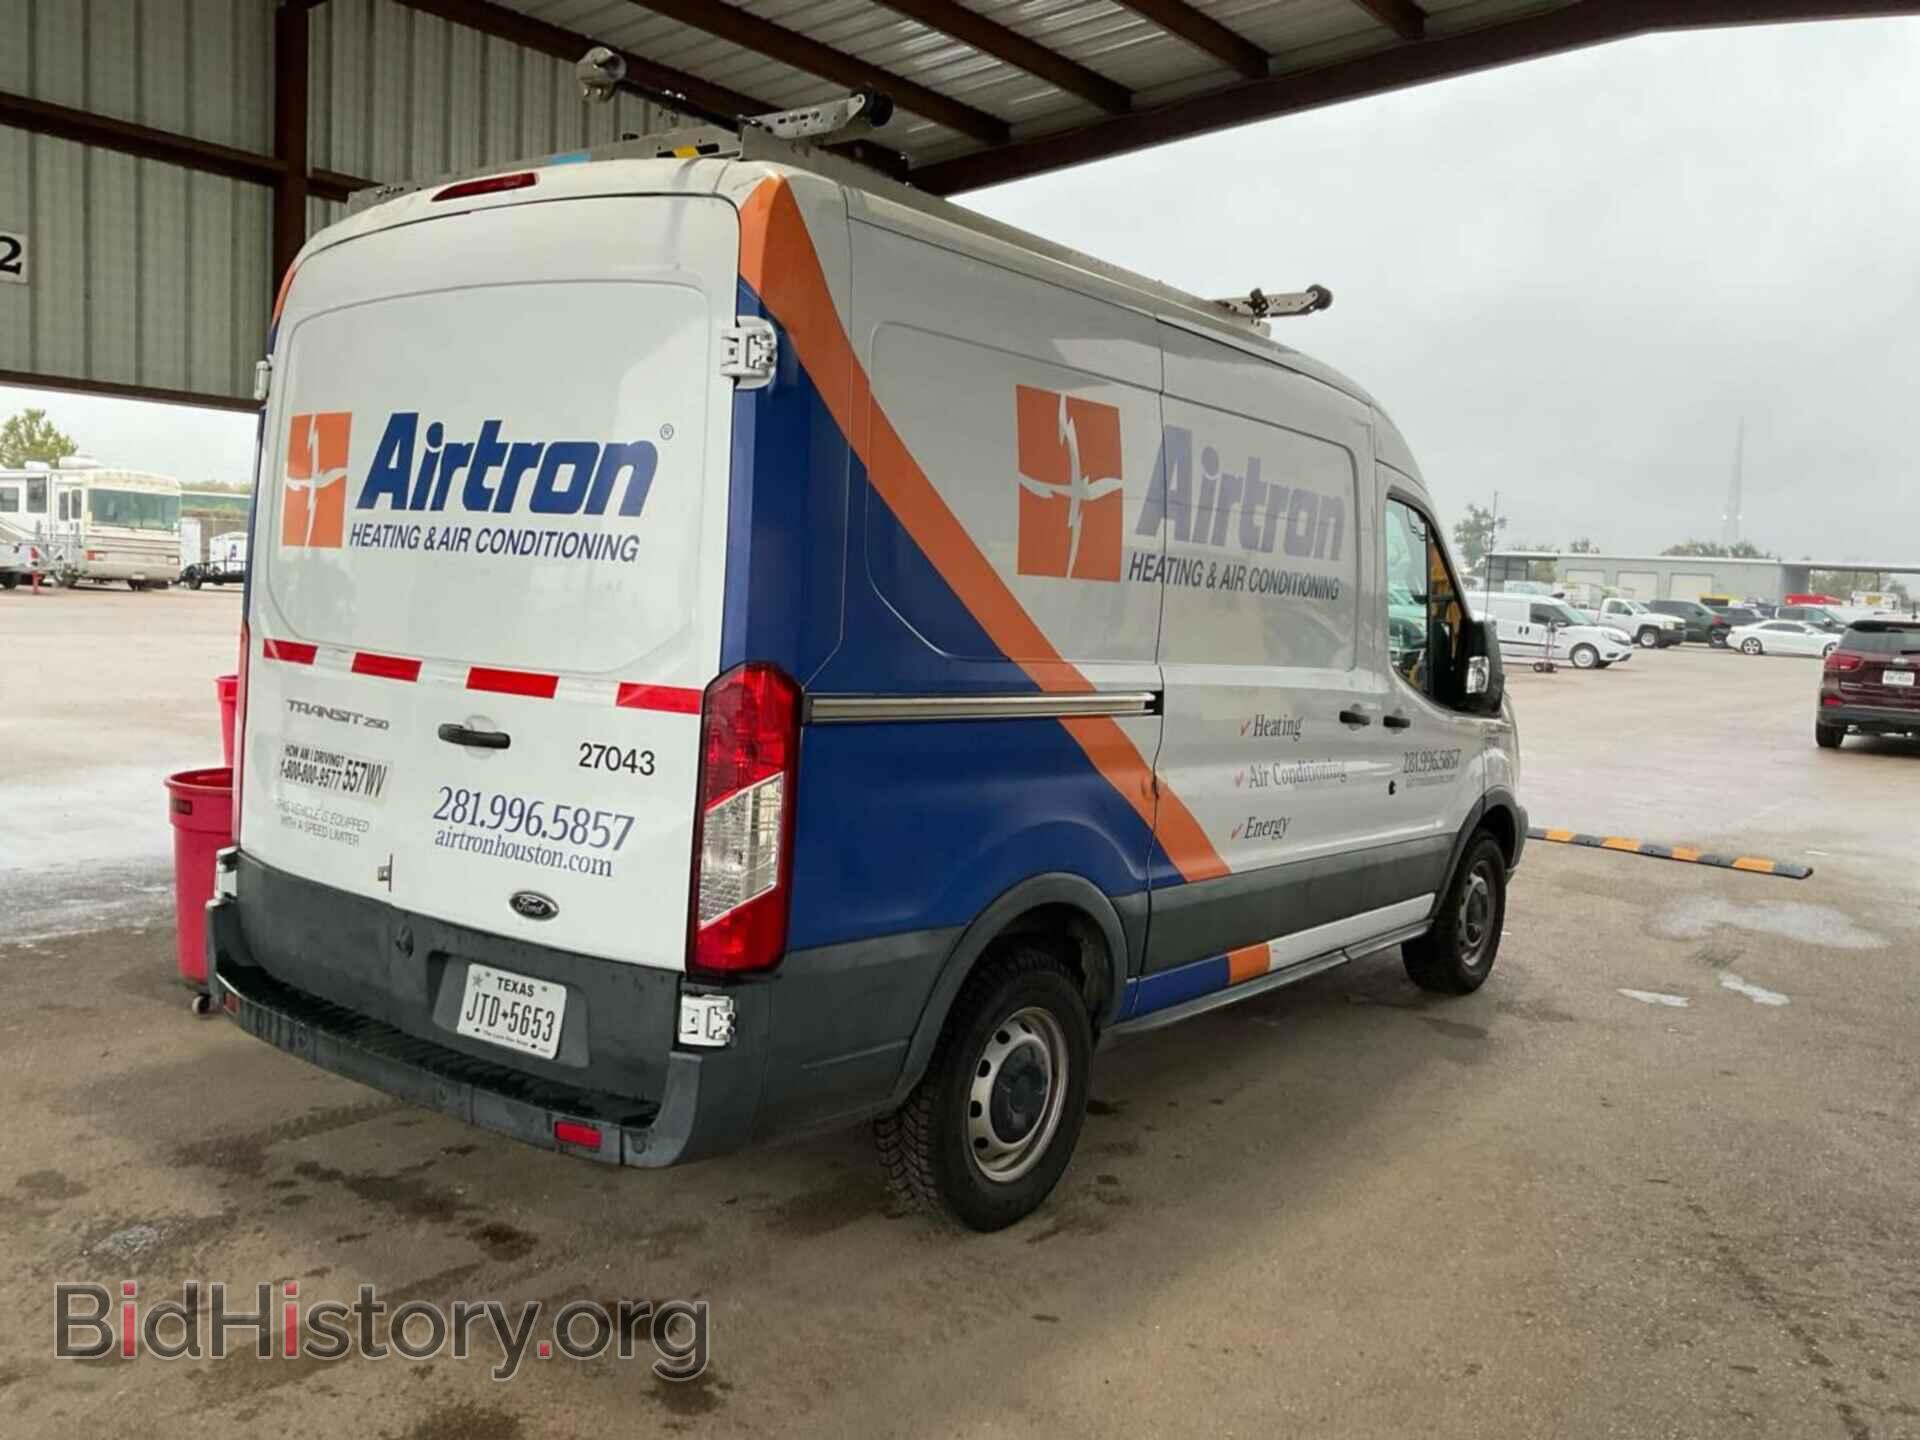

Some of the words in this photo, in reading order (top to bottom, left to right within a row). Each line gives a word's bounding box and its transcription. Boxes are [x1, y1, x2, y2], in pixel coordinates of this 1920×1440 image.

[355, 411, 659, 517] Airtron
[1135, 424, 1346, 562] Airtron
[350, 523, 420, 550] HEATING
[474, 529, 641, 562] CONDITIONING
[1128, 551, 1204, 588] HEATING
[1206, 563, 1216, 588] &
[1220, 564, 1247, 591] AIR
[1249, 567, 1340, 601] CONDITIONING
[286, 699, 364, 725] TRANSIT
[1252, 713, 1303, 742] Heating
[578, 742, 656, 776] 27043
[1249, 765, 1269, 788] Air
[1272, 758, 1347, 783] Conditioning
[342, 759, 387, 798] 557WV
[433, 786, 636, 851] 281.996.5857
[1244, 816, 1291, 841] Energy
[434, 826, 613, 877] airtronhouston.com
[515, 896, 545, 914] Ford
[497, 976, 535, 998] TEXAS
